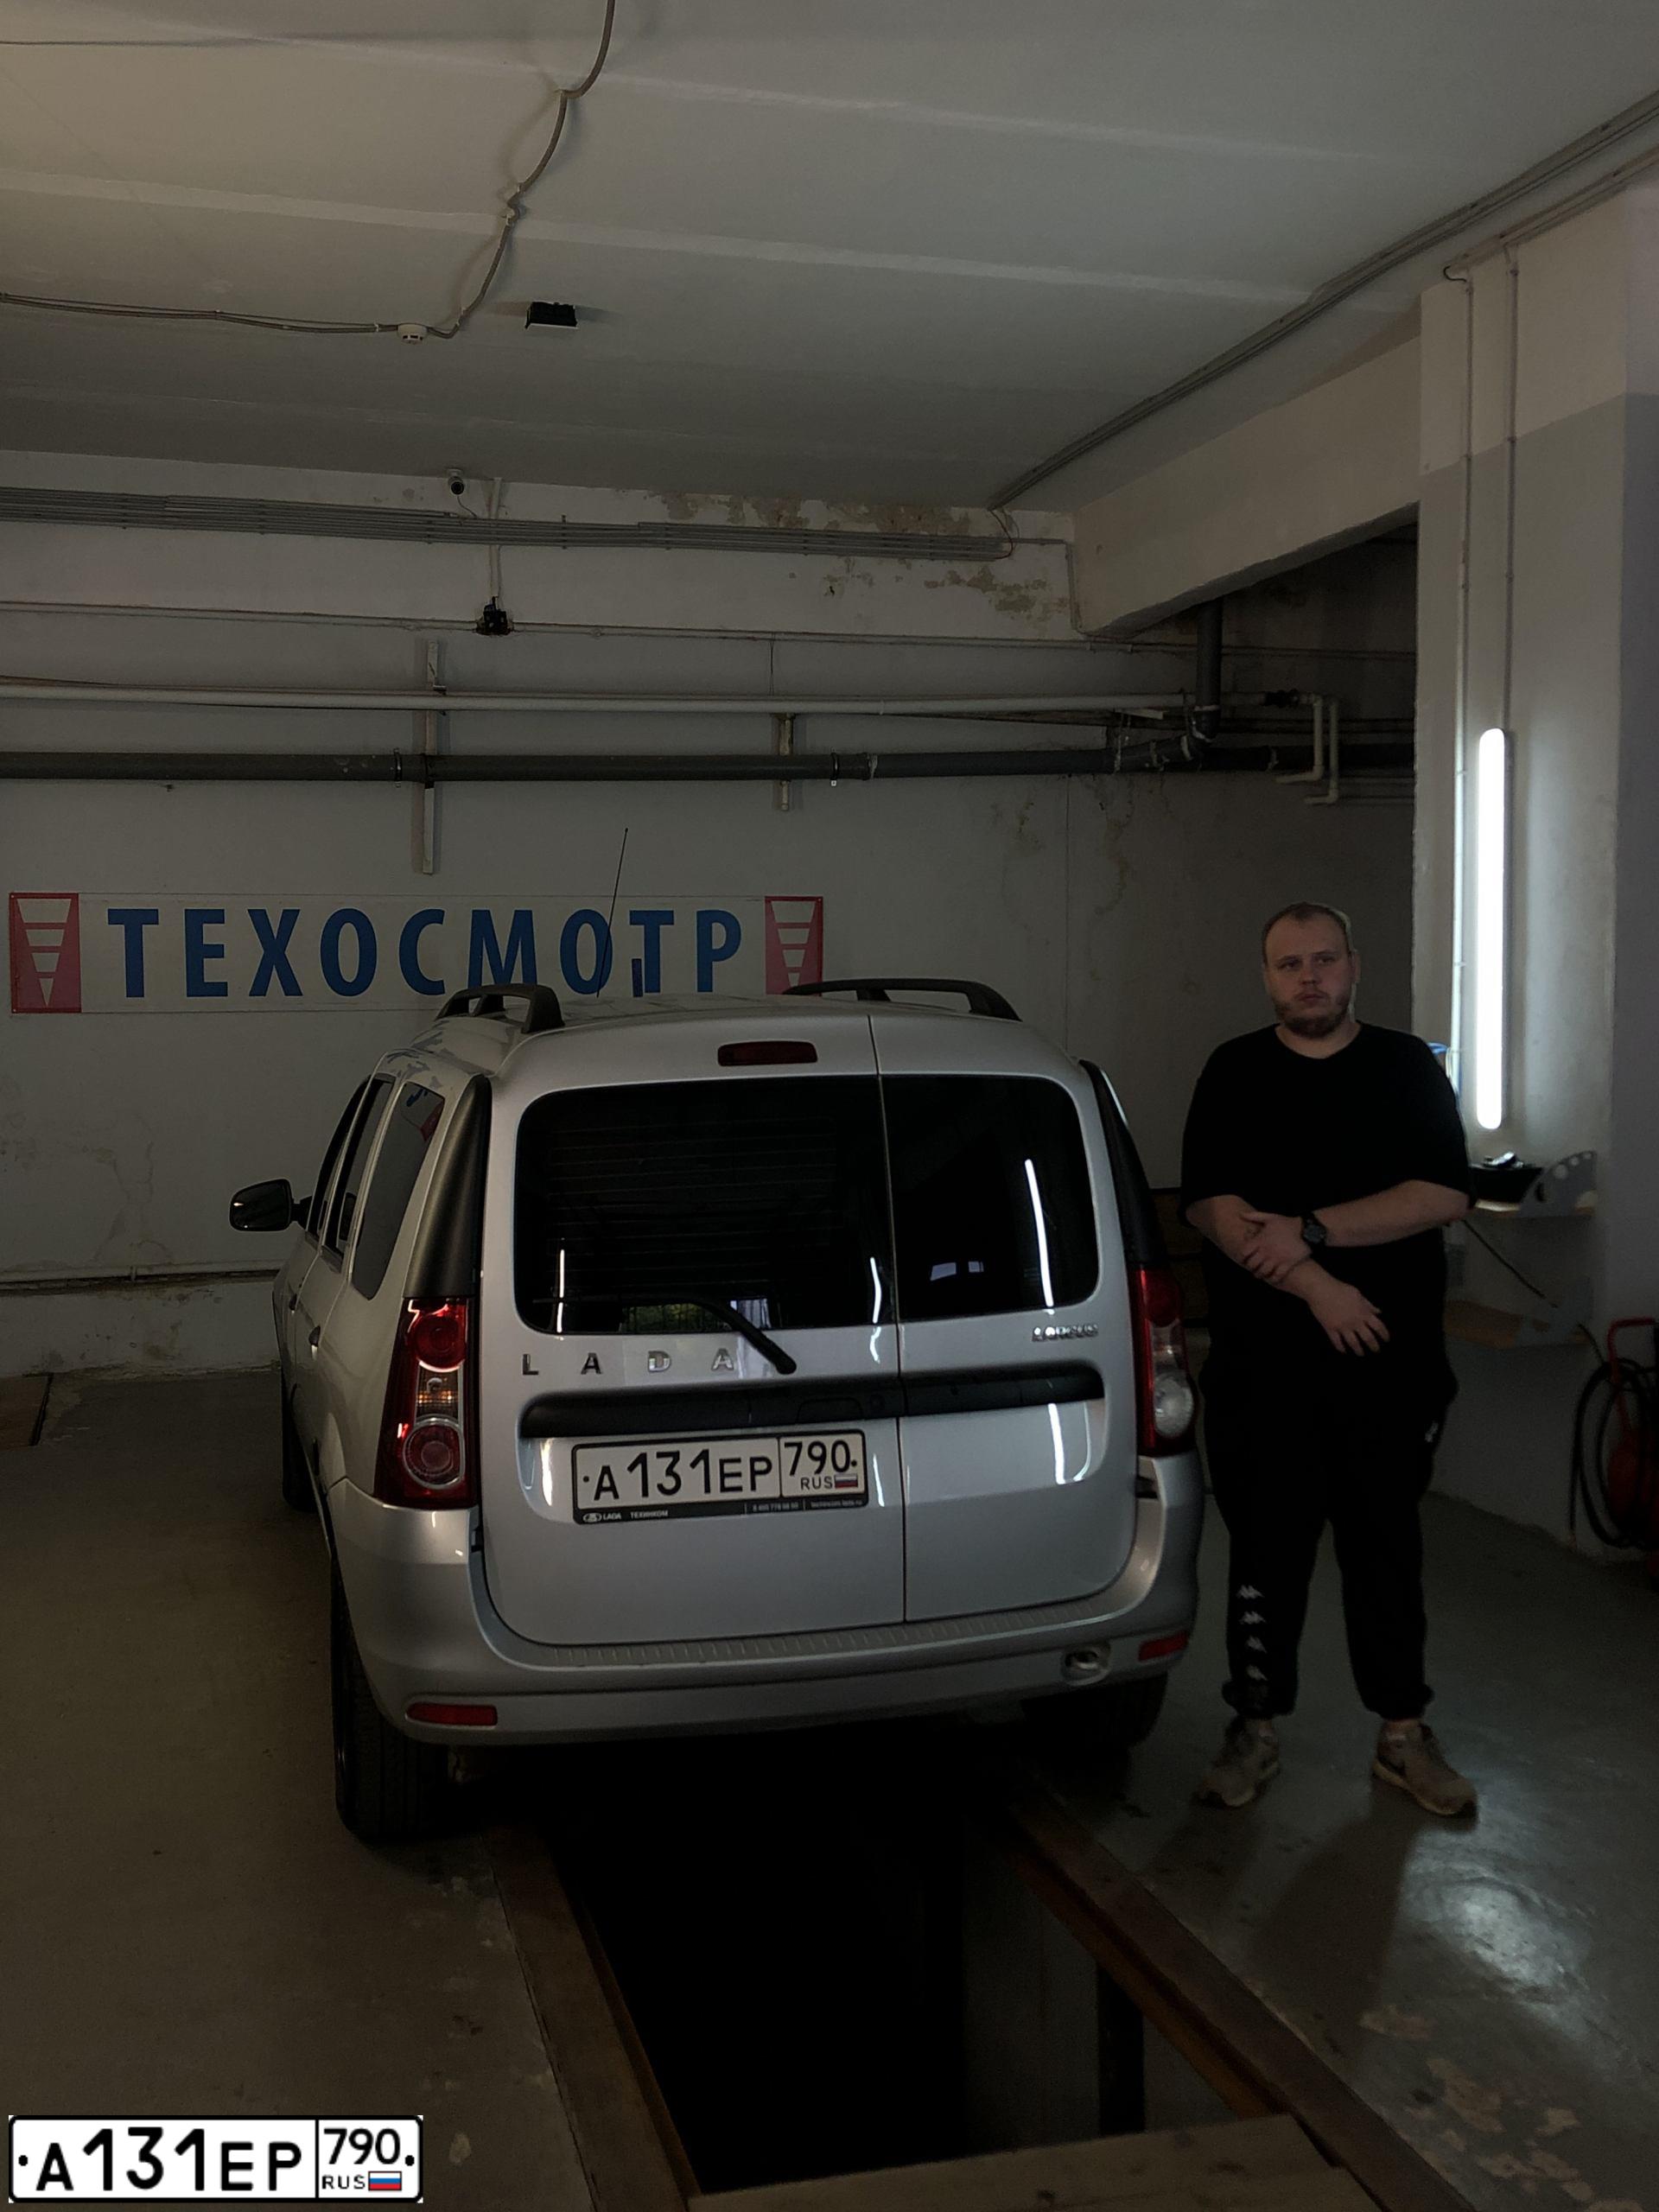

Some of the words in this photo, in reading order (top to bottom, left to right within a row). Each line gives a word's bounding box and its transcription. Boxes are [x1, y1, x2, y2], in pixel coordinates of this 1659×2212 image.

[107, 908, 742, 998] ТЕХОСМОТР
[522, 1348, 735, 1375] LADA
[594, 1449, 772, 1501] А131ЕР
[785, 1440, 850, 1477] 790
[800, 1476, 833, 1491] RUS
